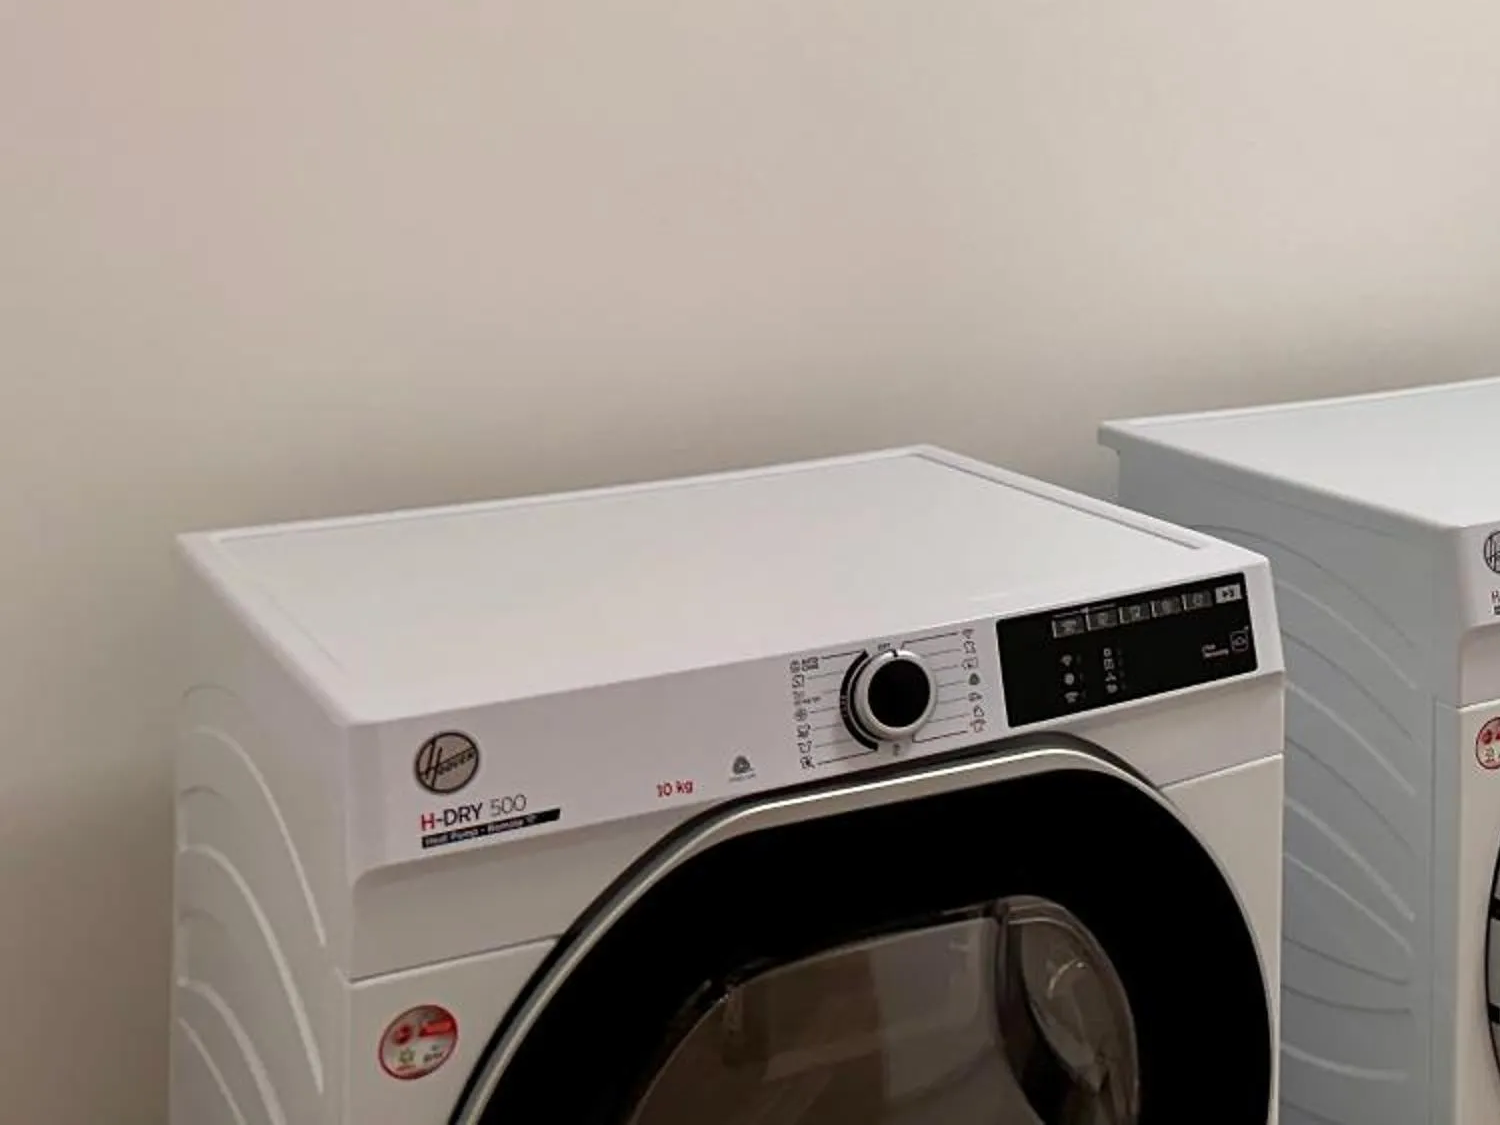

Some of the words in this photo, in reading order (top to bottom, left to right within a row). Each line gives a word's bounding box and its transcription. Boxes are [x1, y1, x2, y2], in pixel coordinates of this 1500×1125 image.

[656, 781, 673, 797] 10
[675, 779, 693, 795] kg
[420, 803, 484, 832] H-DRY
[489, 793, 528, 817] 500
